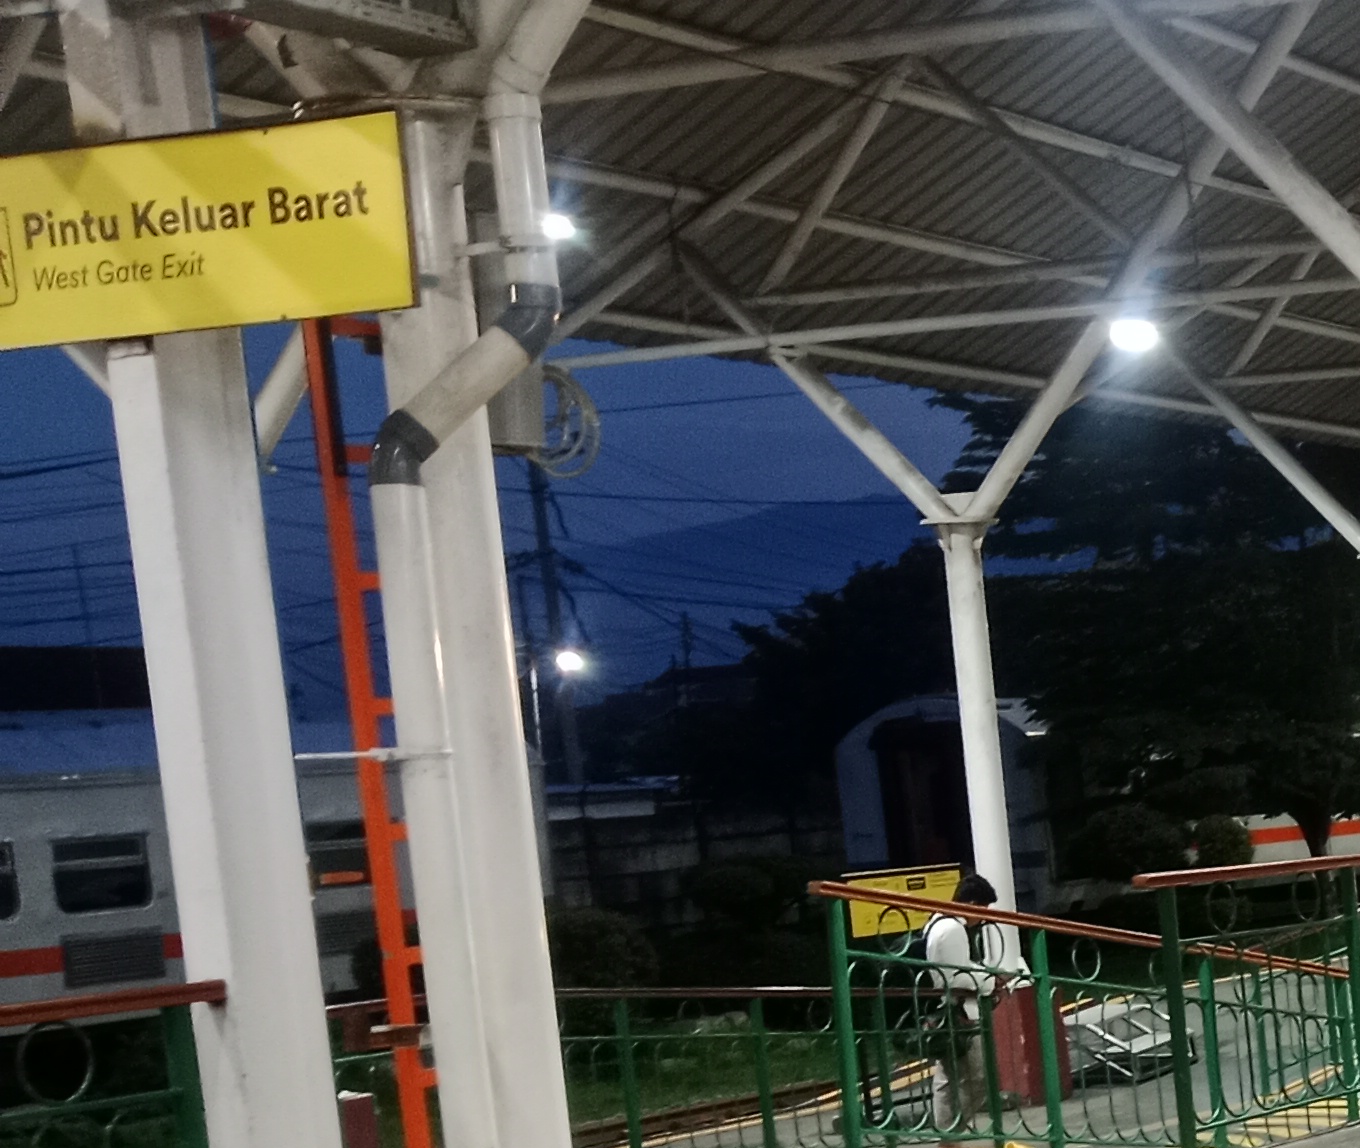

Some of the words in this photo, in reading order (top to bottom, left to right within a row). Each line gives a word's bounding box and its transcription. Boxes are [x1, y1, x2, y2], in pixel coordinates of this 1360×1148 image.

[22, 209, 120, 250] Pintu
[131, 196, 256, 239] Keluar
[267, 181, 370, 225] Barat
[33, 264, 89, 292] West
[97, 257, 153, 286] Gate
[161, 252, 205, 280] Exit
